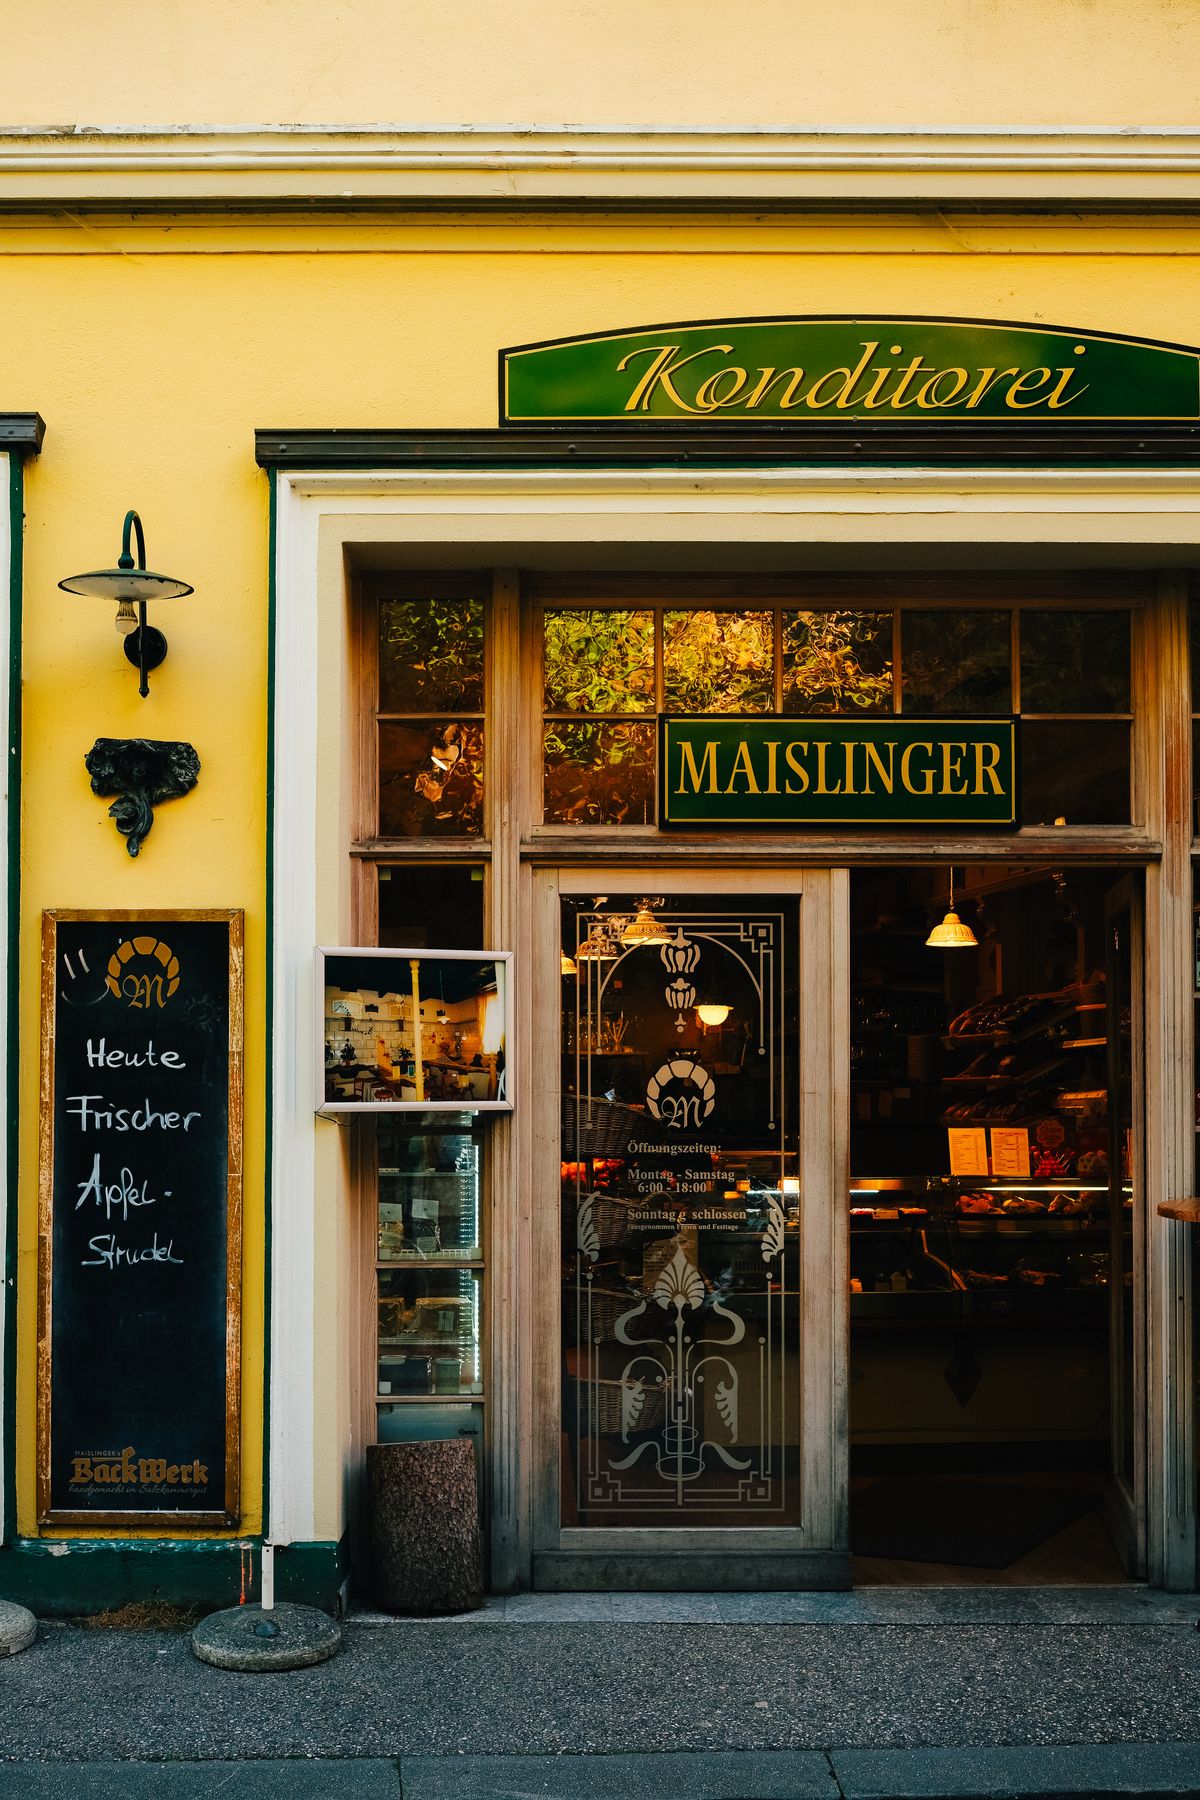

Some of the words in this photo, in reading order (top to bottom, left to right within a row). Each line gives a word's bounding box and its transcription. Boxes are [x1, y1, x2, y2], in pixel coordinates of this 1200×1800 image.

[616, 341, 1089, 414] Konditorei
[674, 741, 1006, 797] MAISLINGER
[87, 1038, 186, 1068] Heute
[66, 1096, 201, 1132] Frischer
[627, 1139, 721, 1156] Öffnungszeiten:
[627, 1169, 673, 1182] Montag
[685, 1169, 735, 1182] Samstag
[638, 1182, 663, 1193] 6:00
[676, 1182, 707, 1193] 18:00
[627, 1209, 676, 1222] Sonntag
[81, 1233, 183, 1270] Strudel
[68, 1484, 125, 1497] handgemacht
[138, 1484, 207, 1498] Salzkammergut
